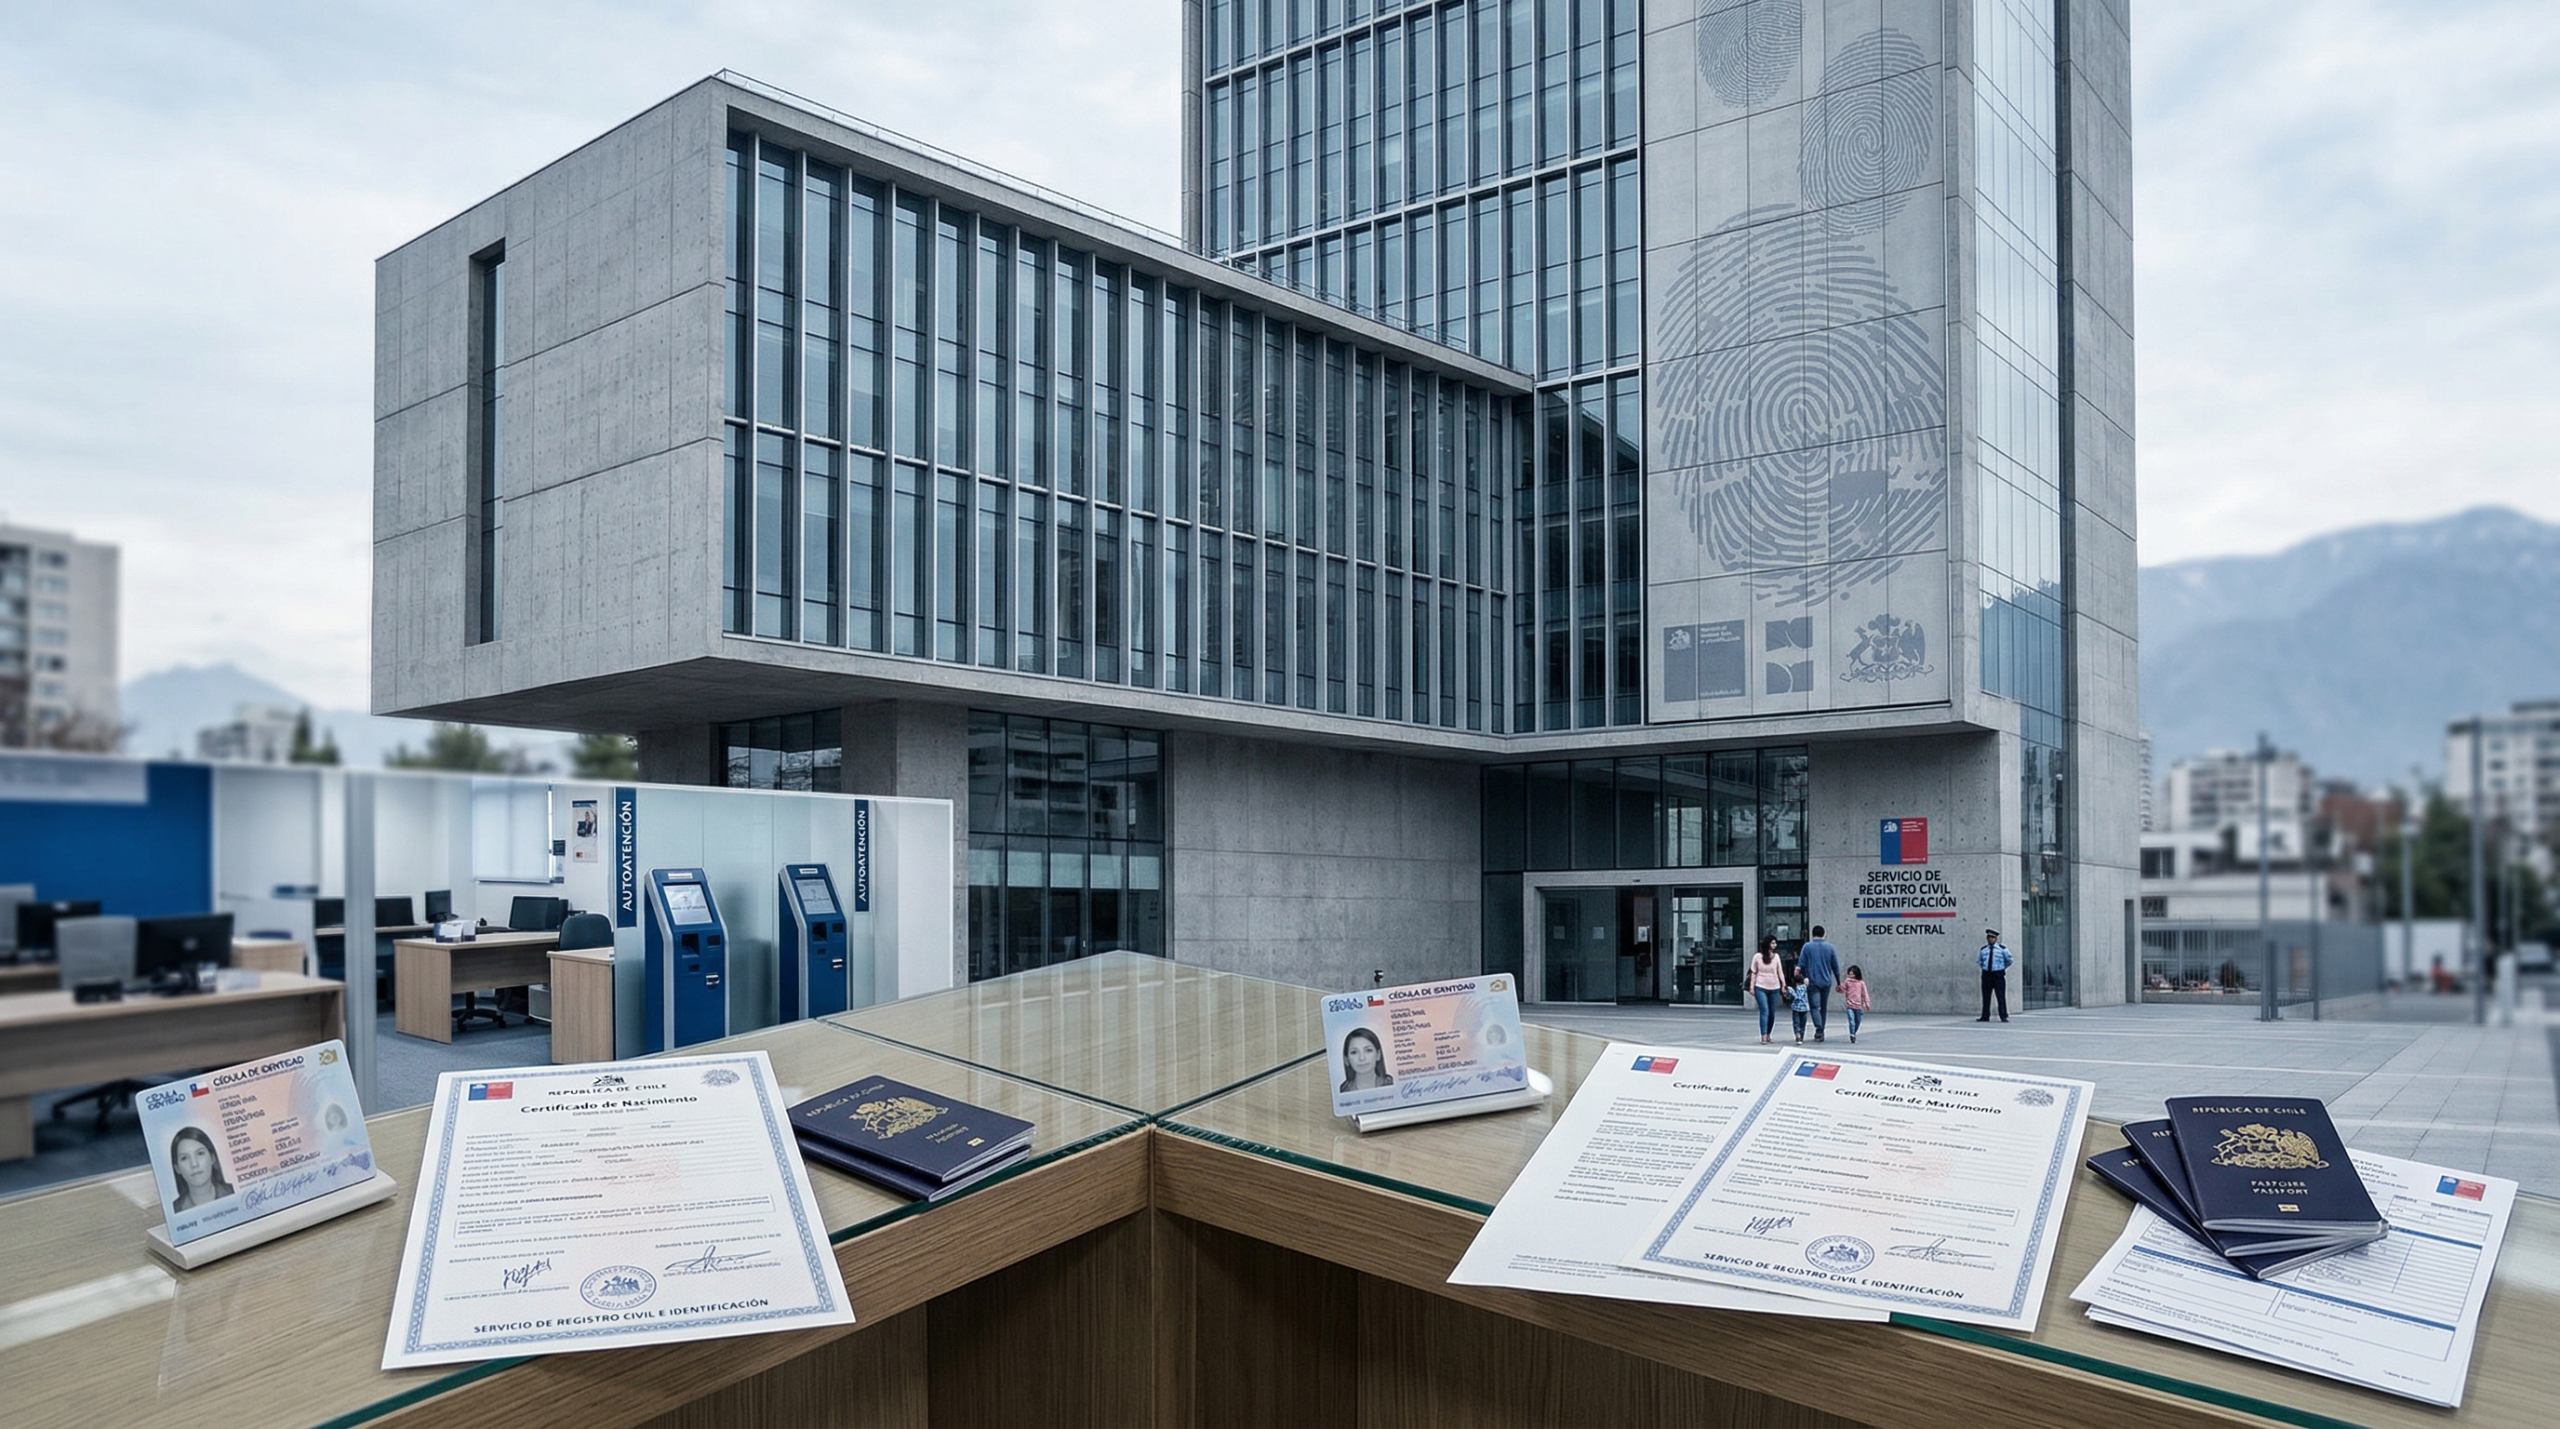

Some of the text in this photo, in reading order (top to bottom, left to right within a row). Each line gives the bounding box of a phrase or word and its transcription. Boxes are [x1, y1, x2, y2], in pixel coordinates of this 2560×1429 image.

[619, 801, 632, 911] AUTOATENCIÓN
[1868, 870, 1941, 882] SERVICIO DE
[1859, 883, 1951, 895] REGISTRO CIVIL
[1853, 894, 1956, 908] E IDENTIFICACIÓN
[1866, 924, 1945, 935] SEDE CENTRAL
[548, 1087, 613, 1096] REPUBLICA
[635, 1083, 667, 1091] CHILE
[1673, 1082, 1734, 1093] Certificado
[521, 1102, 598, 1114] Certificado
[601, 1100, 618, 1108] de
[622, 1095, 698, 1107] Nacimiento
[1835, 1088, 1904, 1103] Certificado
[1907, 1097, 1923, 1105] de
[1925, 1099, 2002, 1114] Matrimonio
[1703, 1252, 1964, 1299] SERVICIO DE REGISTRO CIVIL E IDENTIFICACIÓN
[474, 1299, 769, 1333] SERVICIO DE REGISTRO CIVIL E IDENTIFICACIÓN
